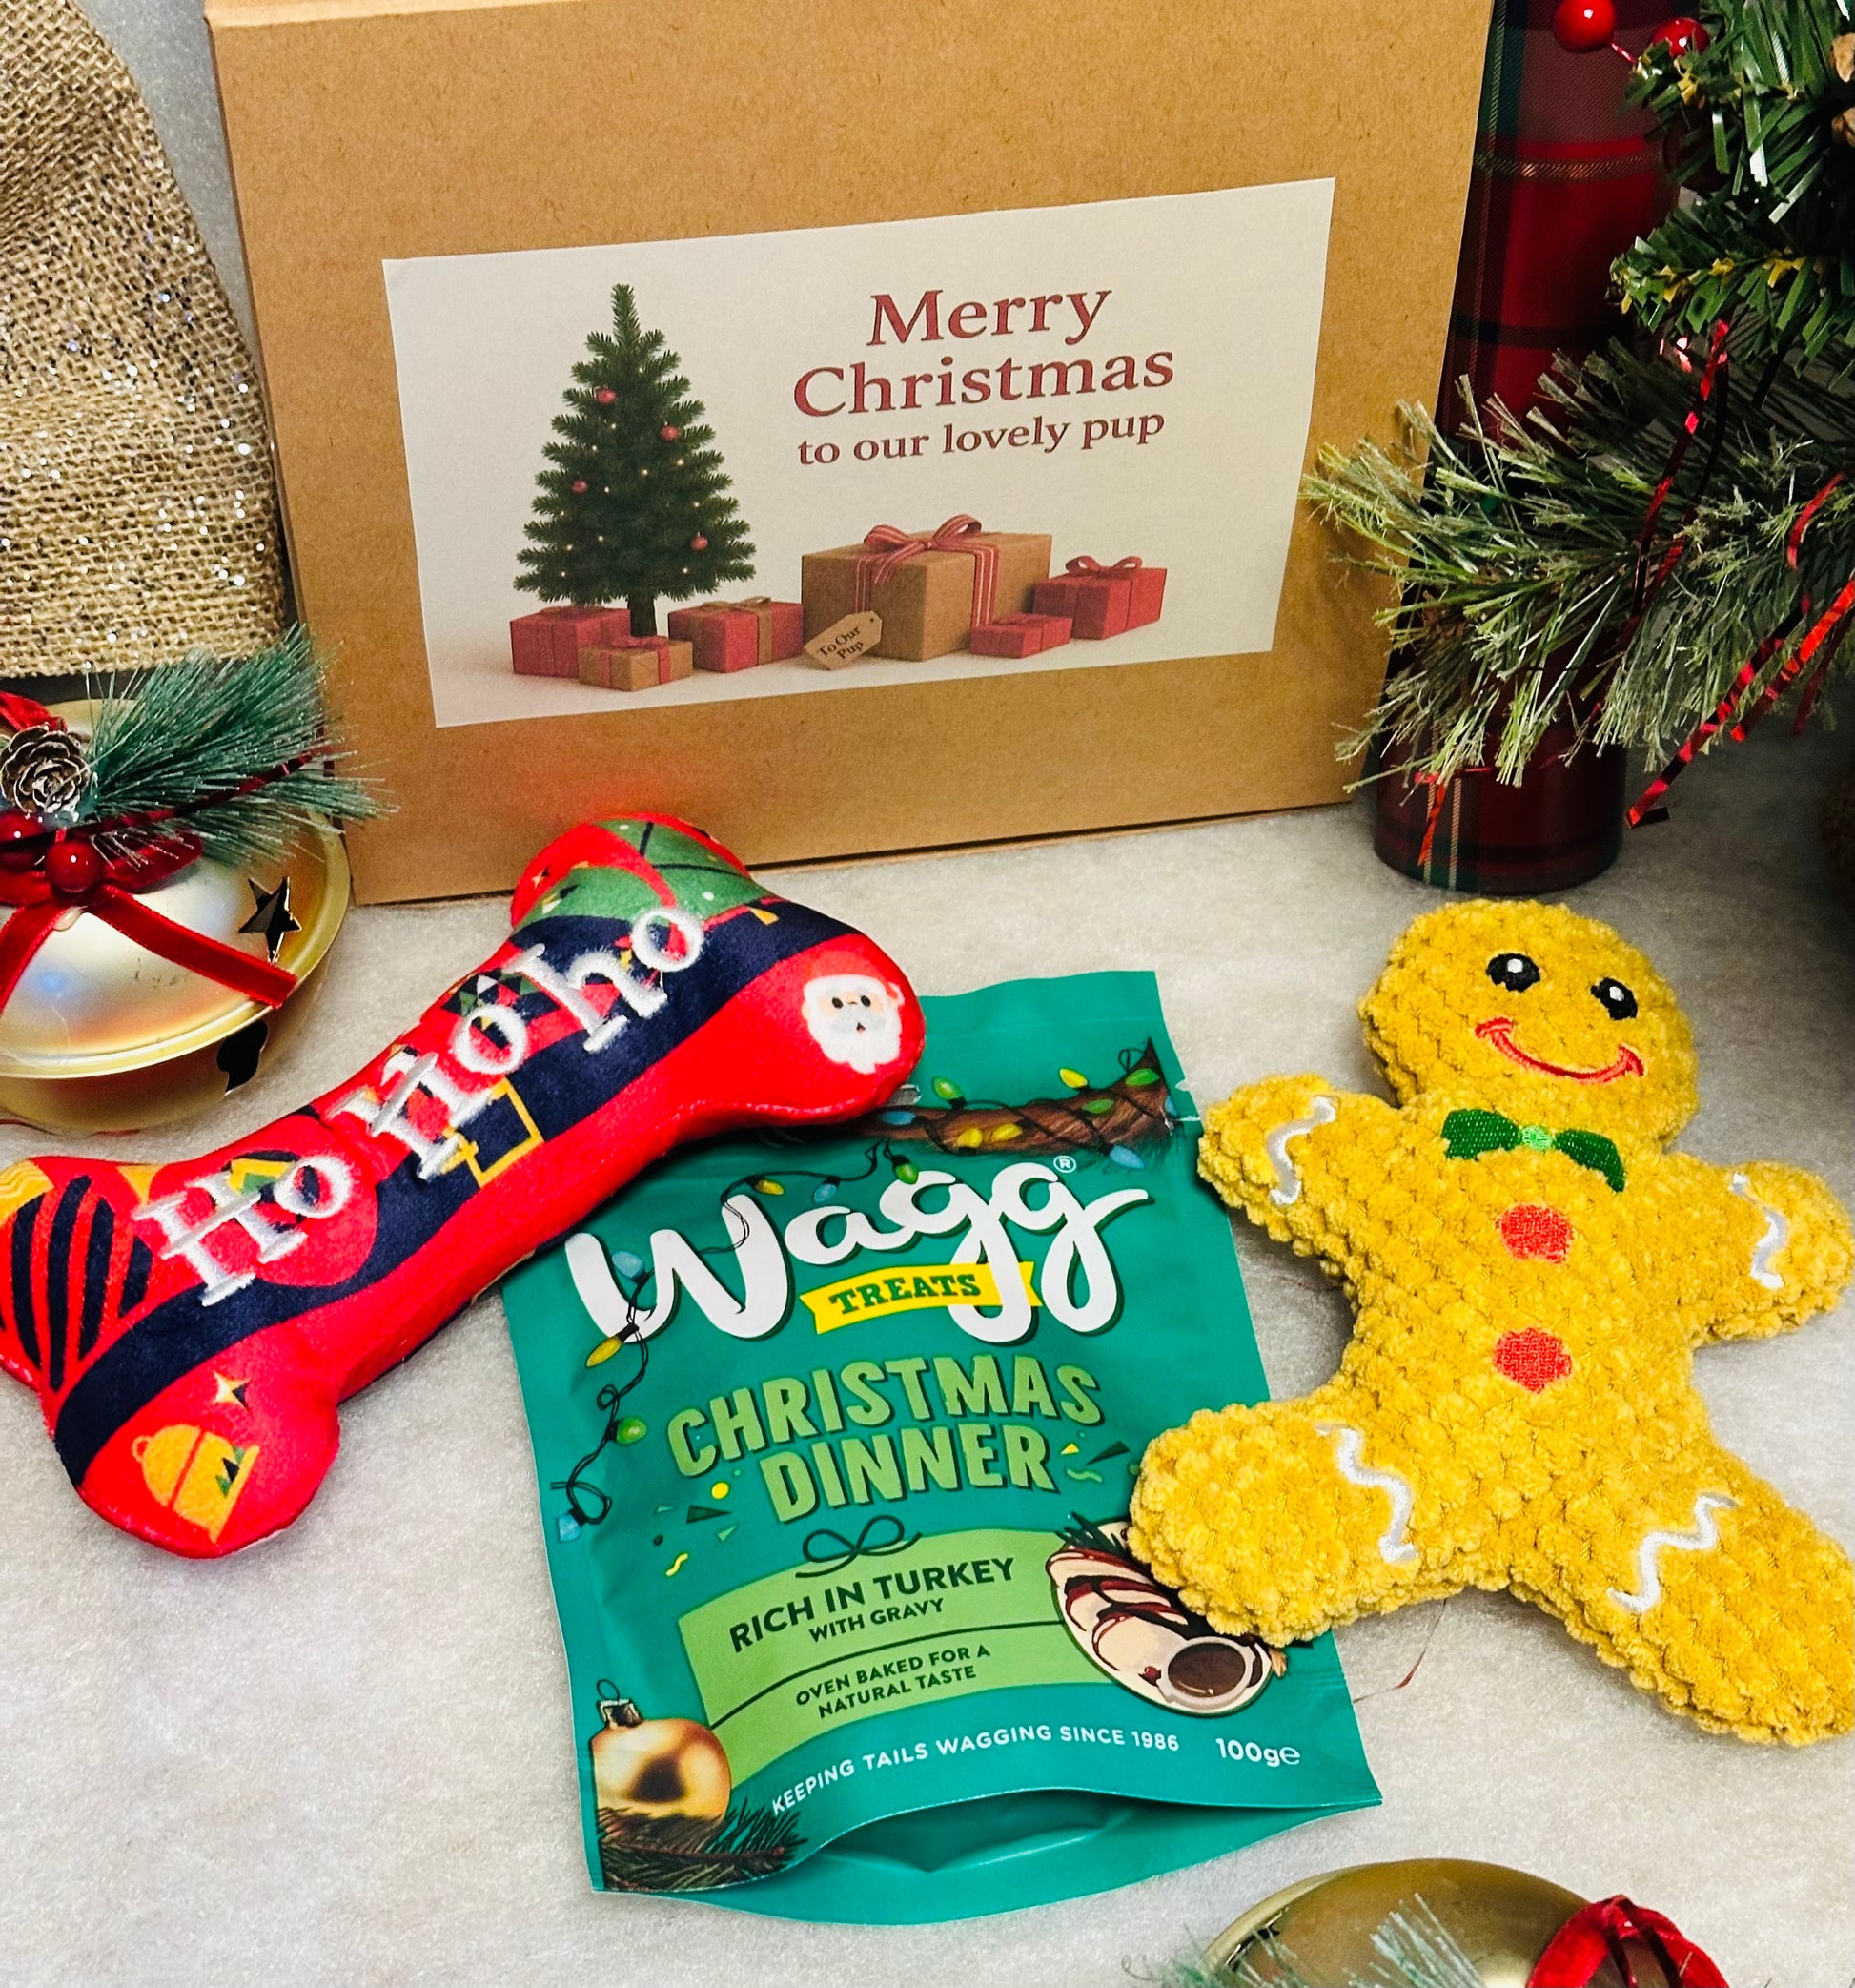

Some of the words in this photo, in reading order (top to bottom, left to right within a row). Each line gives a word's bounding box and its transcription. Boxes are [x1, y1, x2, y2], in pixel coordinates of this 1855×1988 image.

[866, 289, 1112, 346] Merry
[793, 351, 1174, 418] Christmas
[798, 440, 840, 465] to
[853, 433, 929, 461] our
[942, 416, 1071, 454] lovely
[1081, 413, 1165, 450] pup
[818, 644, 837, 656] To
[835, 626, 861, 646] Our
[837, 641, 864, 659] Pup
[132, 1154, 354, 1307] Ho
[325, 1003, 529, 1180] Ho
[505, 907, 705, 1053] ho
[828, 1272, 982, 1316] TREATS
[667, 1354, 1103, 1477] CHRISTMAS
[761, 1424, 1056, 1524] DINNER
[729, 1596, 815, 1653] RICH
[824, 1581, 866, 1613] IN
[873, 1557, 1015, 1600] TURKEY
[809, 1612, 866, 1643] WITH
[869, 1597, 945, 1626] GRAVY
[796, 1673, 850, 1706] OVEN
[856, 1655, 924, 1684] BAKED
[928, 1648, 970, 1667] FOR
[976, 1644, 991, 1658] A
[818, 1683, 912, 1718] NATURAL
[918, 1665, 977, 1690] TASTE
[771, 1760, 855, 1816] KEEPING
[862, 1742, 928, 1771] TAILS
[936, 1724, 1052, 1755] WAGGING
[1060, 1726, 1126, 1747] SINCE
[1131, 1731, 1180, 1752] 1986
